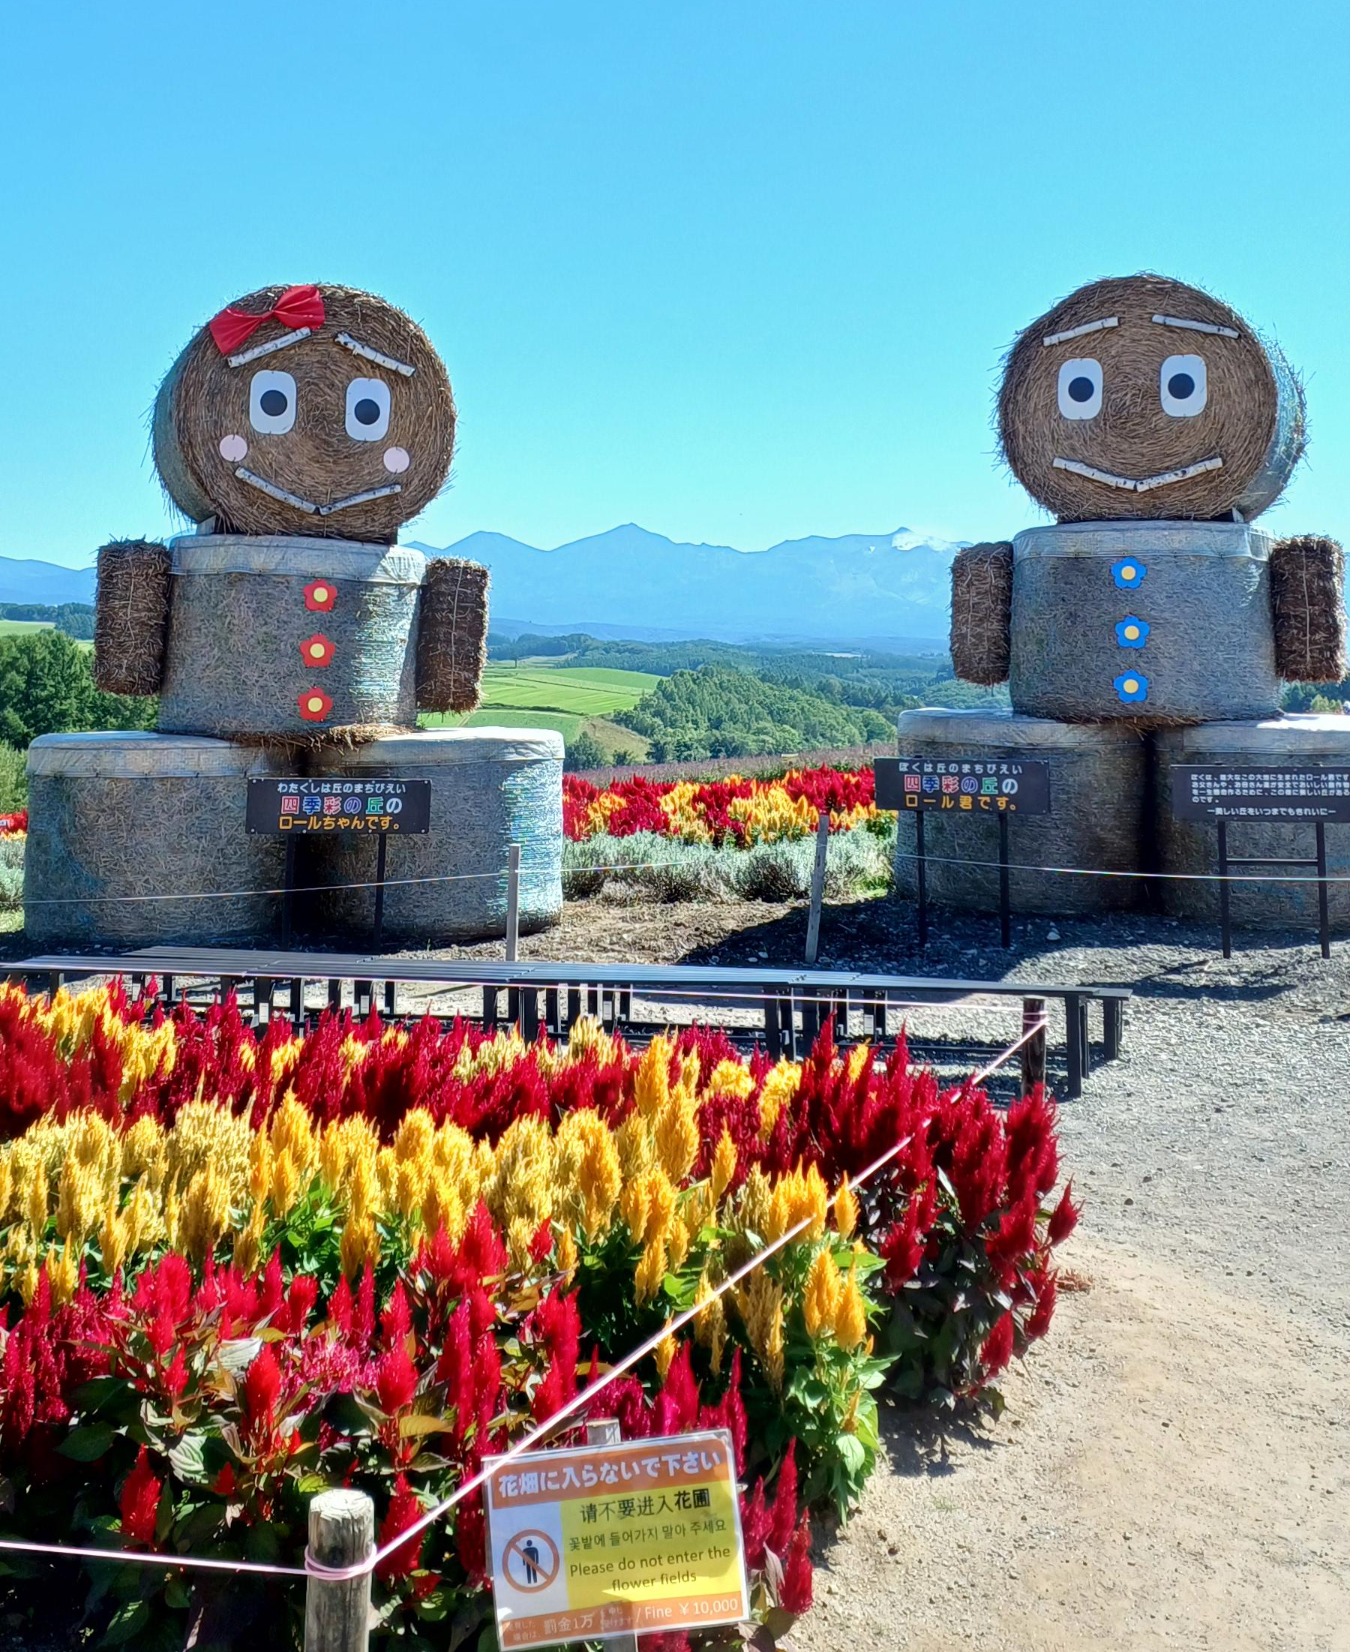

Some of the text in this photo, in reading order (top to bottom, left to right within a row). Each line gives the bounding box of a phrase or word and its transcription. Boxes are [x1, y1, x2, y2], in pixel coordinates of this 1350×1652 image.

[899, 762, 1023, 775] ぼくは丘のまちびえい
[277, 782, 406, 794] わたくしは丘のまちびえい
[904, 775, 1019, 795] 四季彩の丘の
[281, 796, 403, 815] 四季彩の丘の
[906, 795, 1017, 811] ロール君です。
[278, 816, 401, 831] ロールちゃんです。
[498, 1451, 721, 1498] 花畑に入らないで下さい
[579, 1487, 711, 1524] 请不要进入花圃
[569, 1518, 727, 1552] 꽃밭에 들어가지 말아 주세요
[570, 1545, 731, 1577] Please do not enter the
[612, 1569, 697, 1592] flower fields
[644, 1605, 673, 1620] Fine
